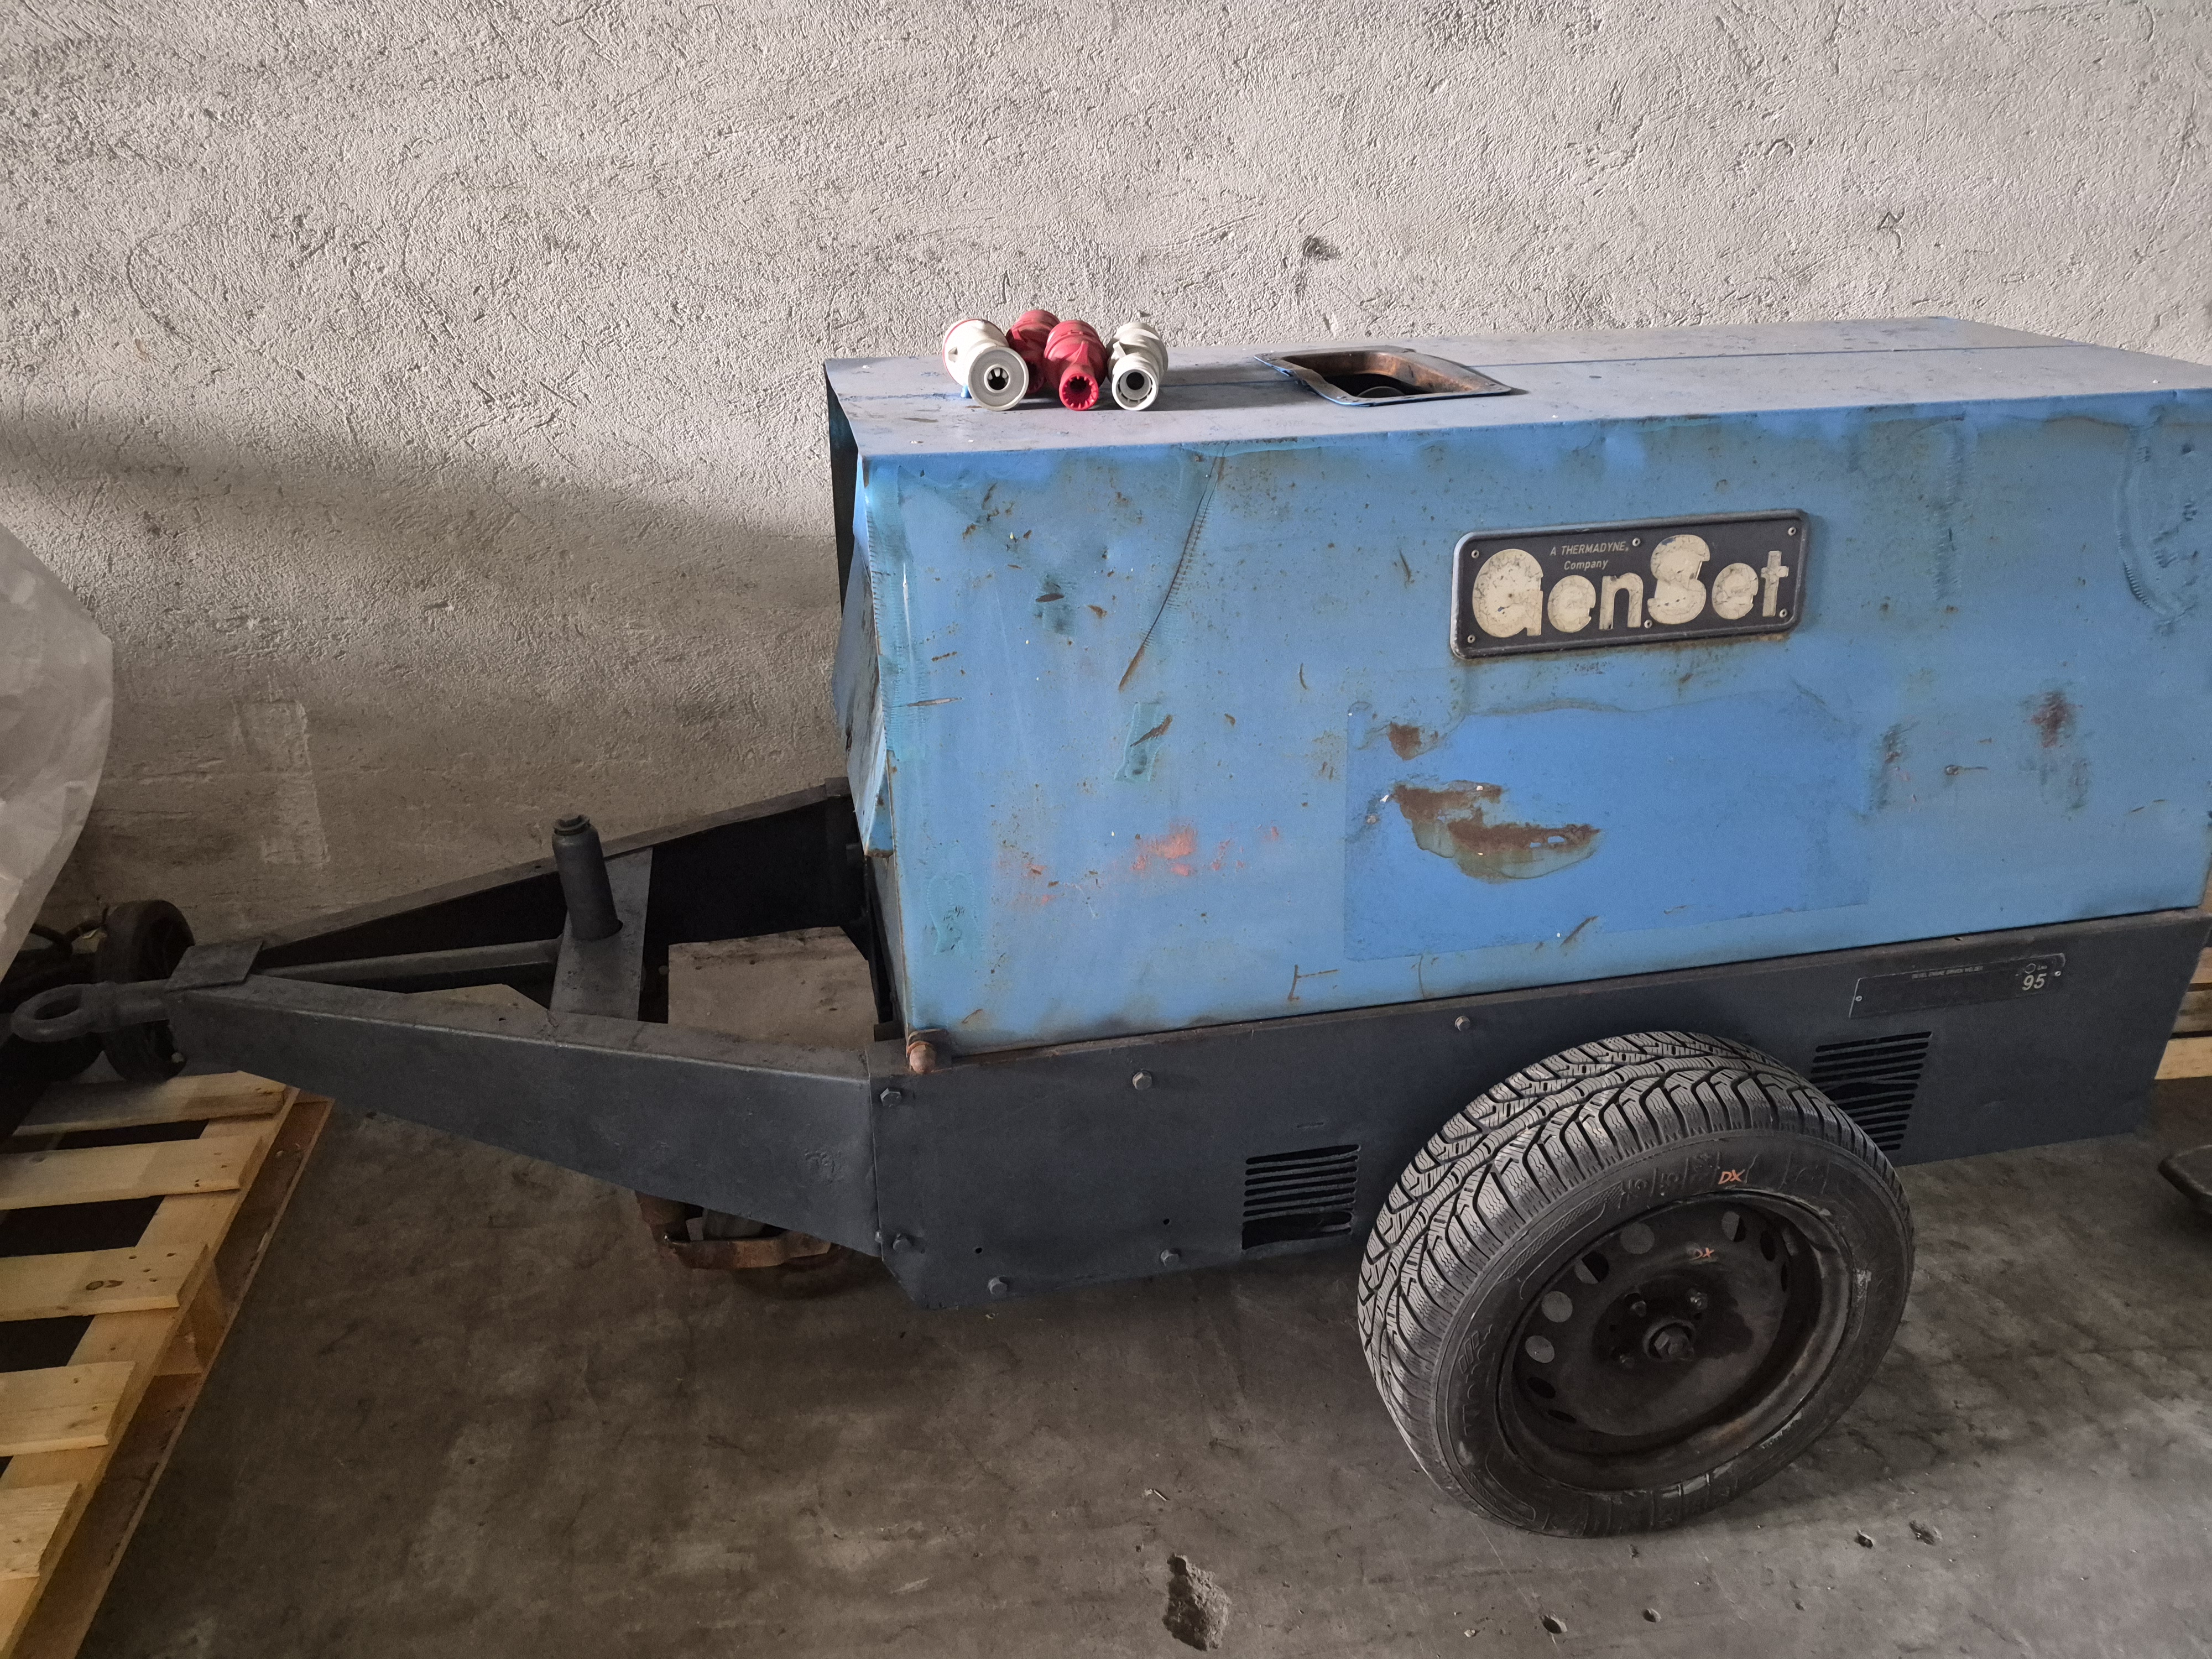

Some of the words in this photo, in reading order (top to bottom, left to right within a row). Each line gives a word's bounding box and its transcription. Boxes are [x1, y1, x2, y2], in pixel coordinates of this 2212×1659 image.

[1550, 544, 1558, 556] A
[1563, 558, 1609, 571] Company
[2021, 972, 2047, 991] 95
[1718, 1168, 1746, 1186] DX
